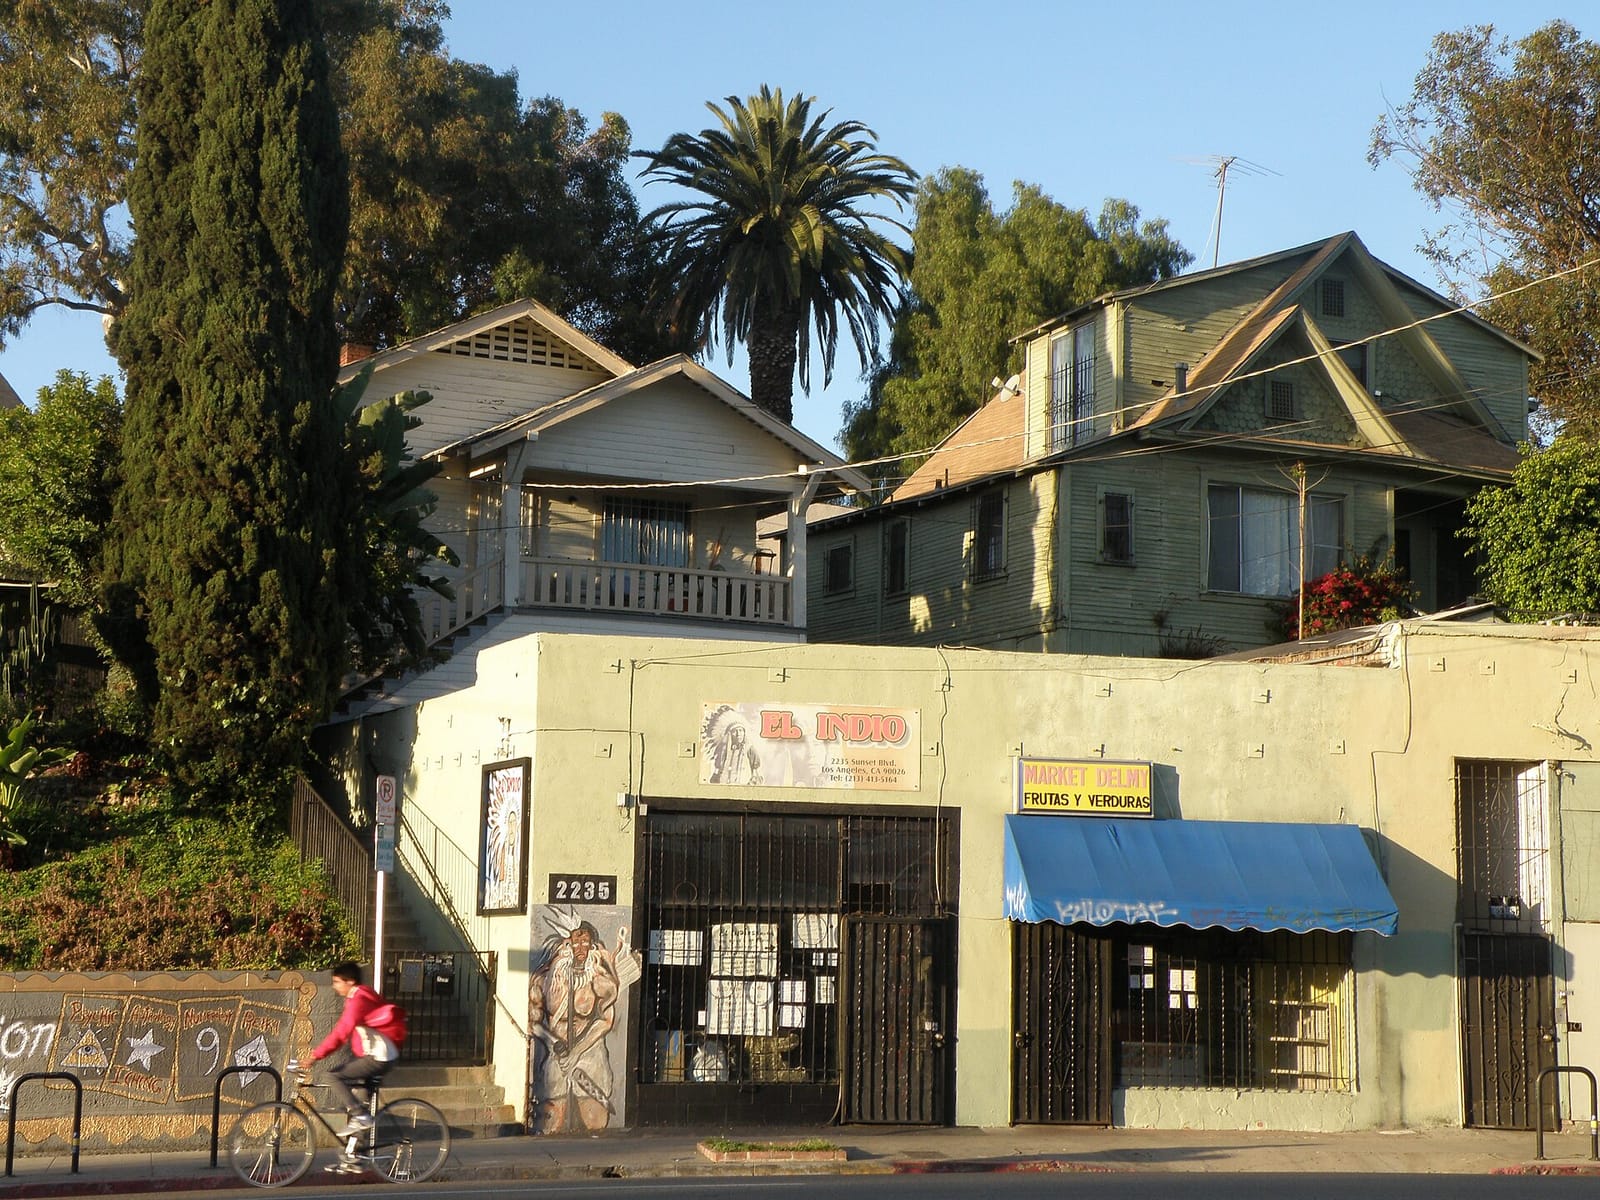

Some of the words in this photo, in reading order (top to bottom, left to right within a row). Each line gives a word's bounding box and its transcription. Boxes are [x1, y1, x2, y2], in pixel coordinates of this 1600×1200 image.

[760, 710, 802, 739] EL
[816, 712, 906, 743] INDIO
[851, 759, 876, 767] Sunset
[1023, 764, 1088, 787] MARKET
[1096, 767, 1149, 789] DELMY
[1024, 792, 1069, 806] FRUTAS
[1074, 794, 1082, 806] Y
[1088, 794, 1150, 808] VERDURAS
[556, 881, 610, 900] 2235
[196, 1027, 220, 1076] 9
